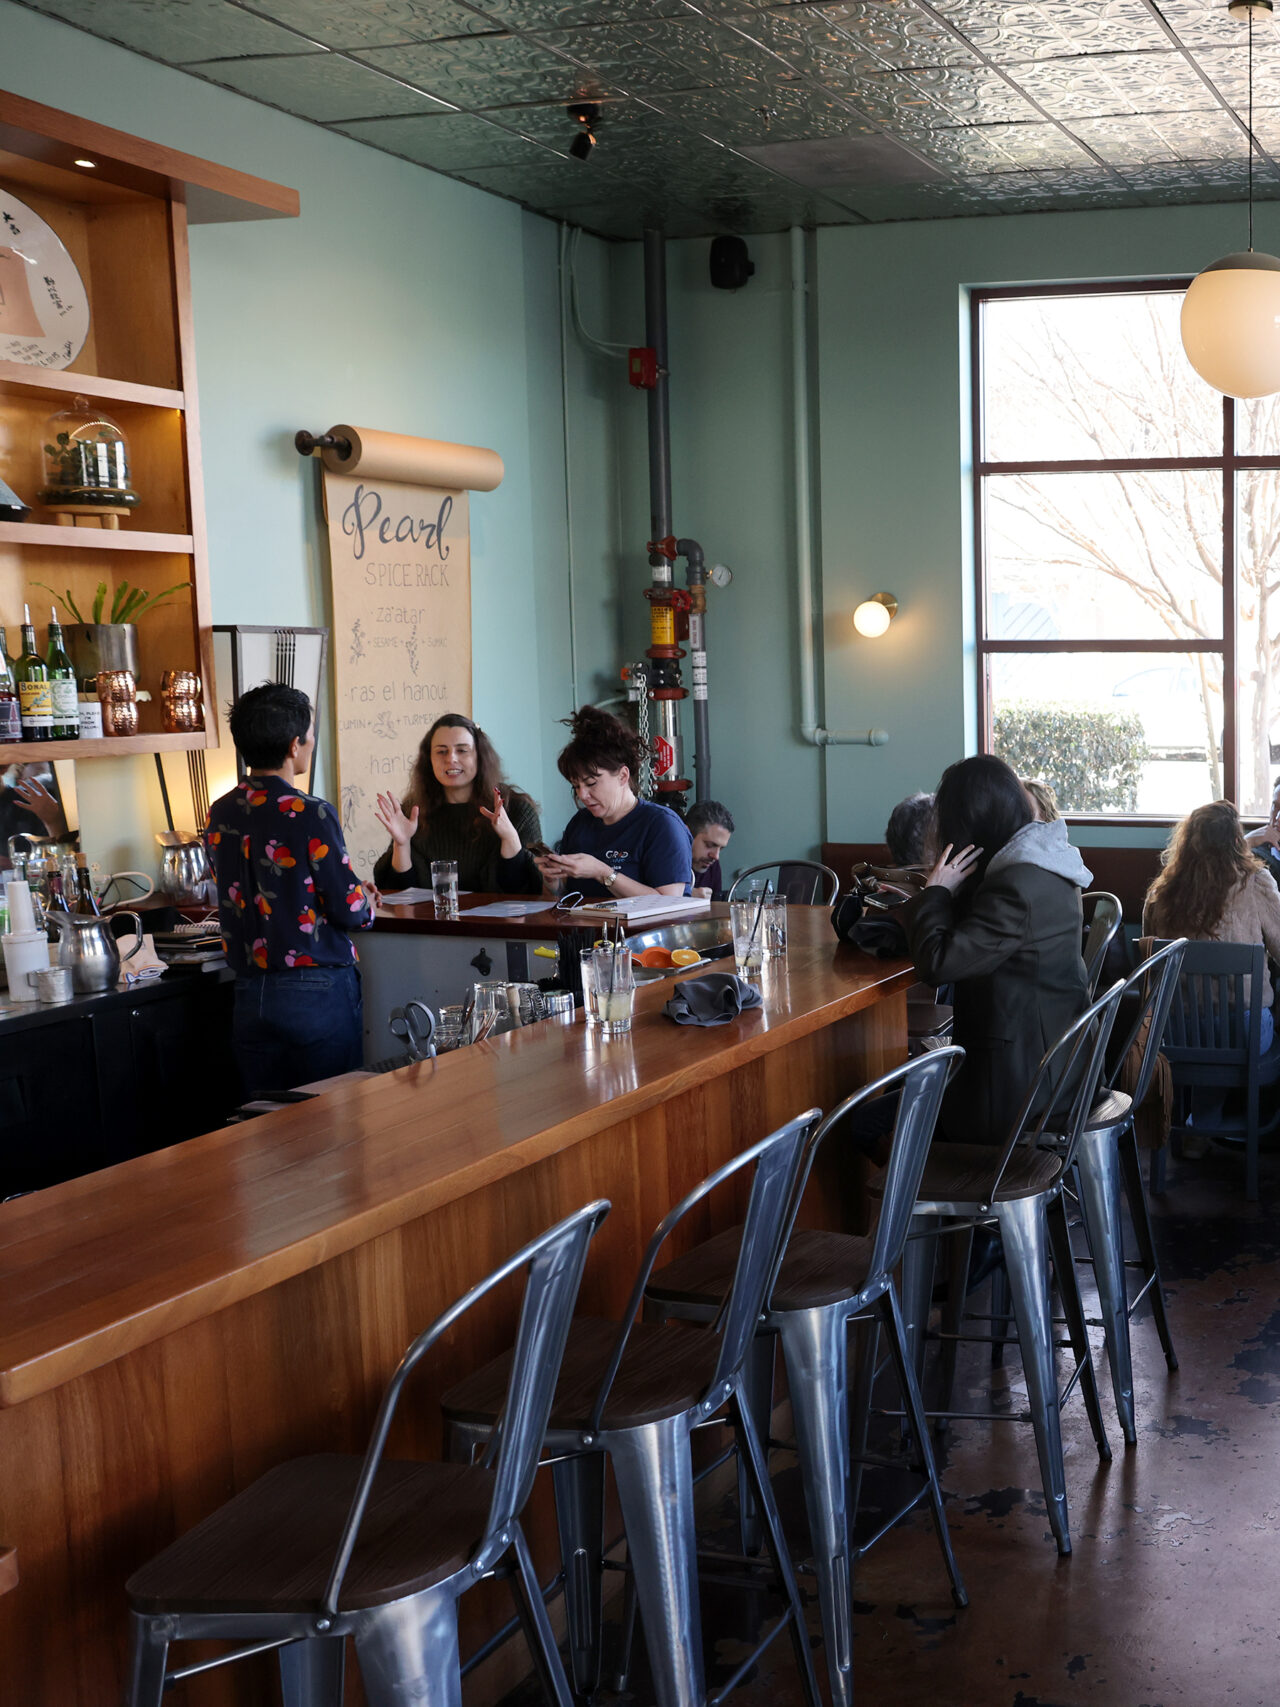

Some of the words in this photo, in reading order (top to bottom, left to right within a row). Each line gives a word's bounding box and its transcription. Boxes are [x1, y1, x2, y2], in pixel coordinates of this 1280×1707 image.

[342, 484, 453, 561] Pearl
[365, 562, 412, 587] SPICE
[416, 563, 449, 587] RACK
[350, 685, 376, 702] ras
[382, 680, 396, 701] el
[402, 681, 448, 701] hanout
[370, 752, 415, 776] haris
